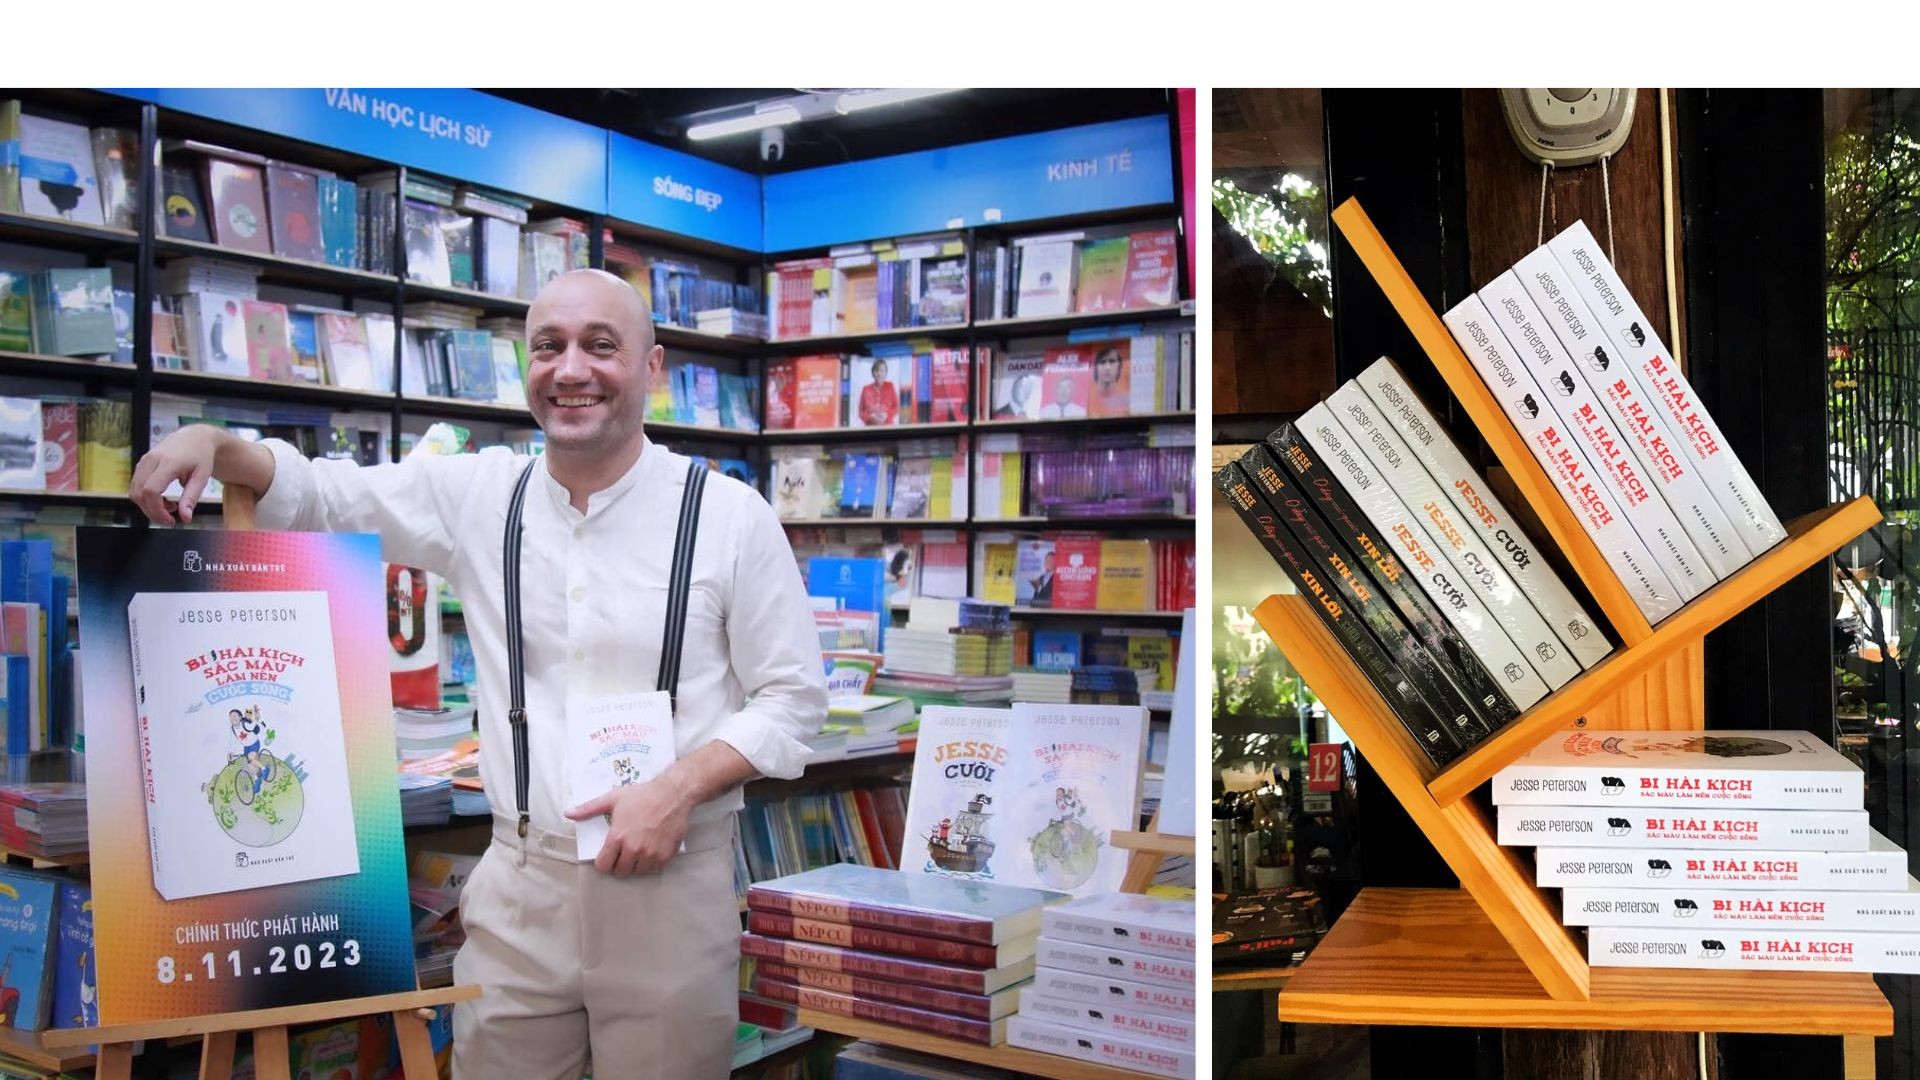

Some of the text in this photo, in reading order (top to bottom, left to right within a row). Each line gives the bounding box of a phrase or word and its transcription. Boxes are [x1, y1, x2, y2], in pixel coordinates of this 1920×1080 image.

[1546, 98, 1550, 106] 1
[1592, 93, 1597, 101] 3
[372, 98, 414, 128] HỌC
[420, 112, 460, 140] LỊCH
[465, 124, 491, 148] SỬ
[1048, 159, 1097, 181] KINH
[1649, 355, 1668, 376] BI
[1664, 378, 1691, 411] HÀI
[1613, 379, 1632, 400] BI
[1628, 401, 1655, 435] HÀI
[1580, 403, 1598, 424] BI
[1594, 425, 1620, 459] HÀI
[1290, 445, 1313, 470] JESSE
[1543, 426, 1561, 447] BI
[1558, 448, 1584, 482] HÀI
[1261, 466, 1284, 491] JESSE
[1234, 482, 1256, 508] JESSE
[1455, 479, 1499, 528] JESSE
[1424, 501, 1467, 550] JESSE
[1356, 532, 1381, 561] XIN
[1392, 522, 1436, 572] JESSE
[1328, 552, 1350, 579] XIN
[1301, 569, 1324, 599] XIN
[185, 655, 208, 672] BI
[934, 740, 1008, 767] JESSE
[1312, 752, 1338, 782] 12
[1640, 778, 1659, 788] BI
[1667, 776, 1700, 789] HÀI
[1647, 819, 1665, 830] BI
[1673, 818, 1707, 830] HÀI
[1687, 860, 1705, 871] BI
[1713, 858, 1746, 870] HÀI
[1713, 900, 1732, 911] BI
[1740, 898, 1773, 911] HÀI
[176, 912, 339, 945] CHÍNH THỨC PHÁT HÀNH
[1741, 941, 1759, 952] BI
[1768, 939, 1801, 951] HÀI
[157, 940, 360, 984] 8.11.2023
